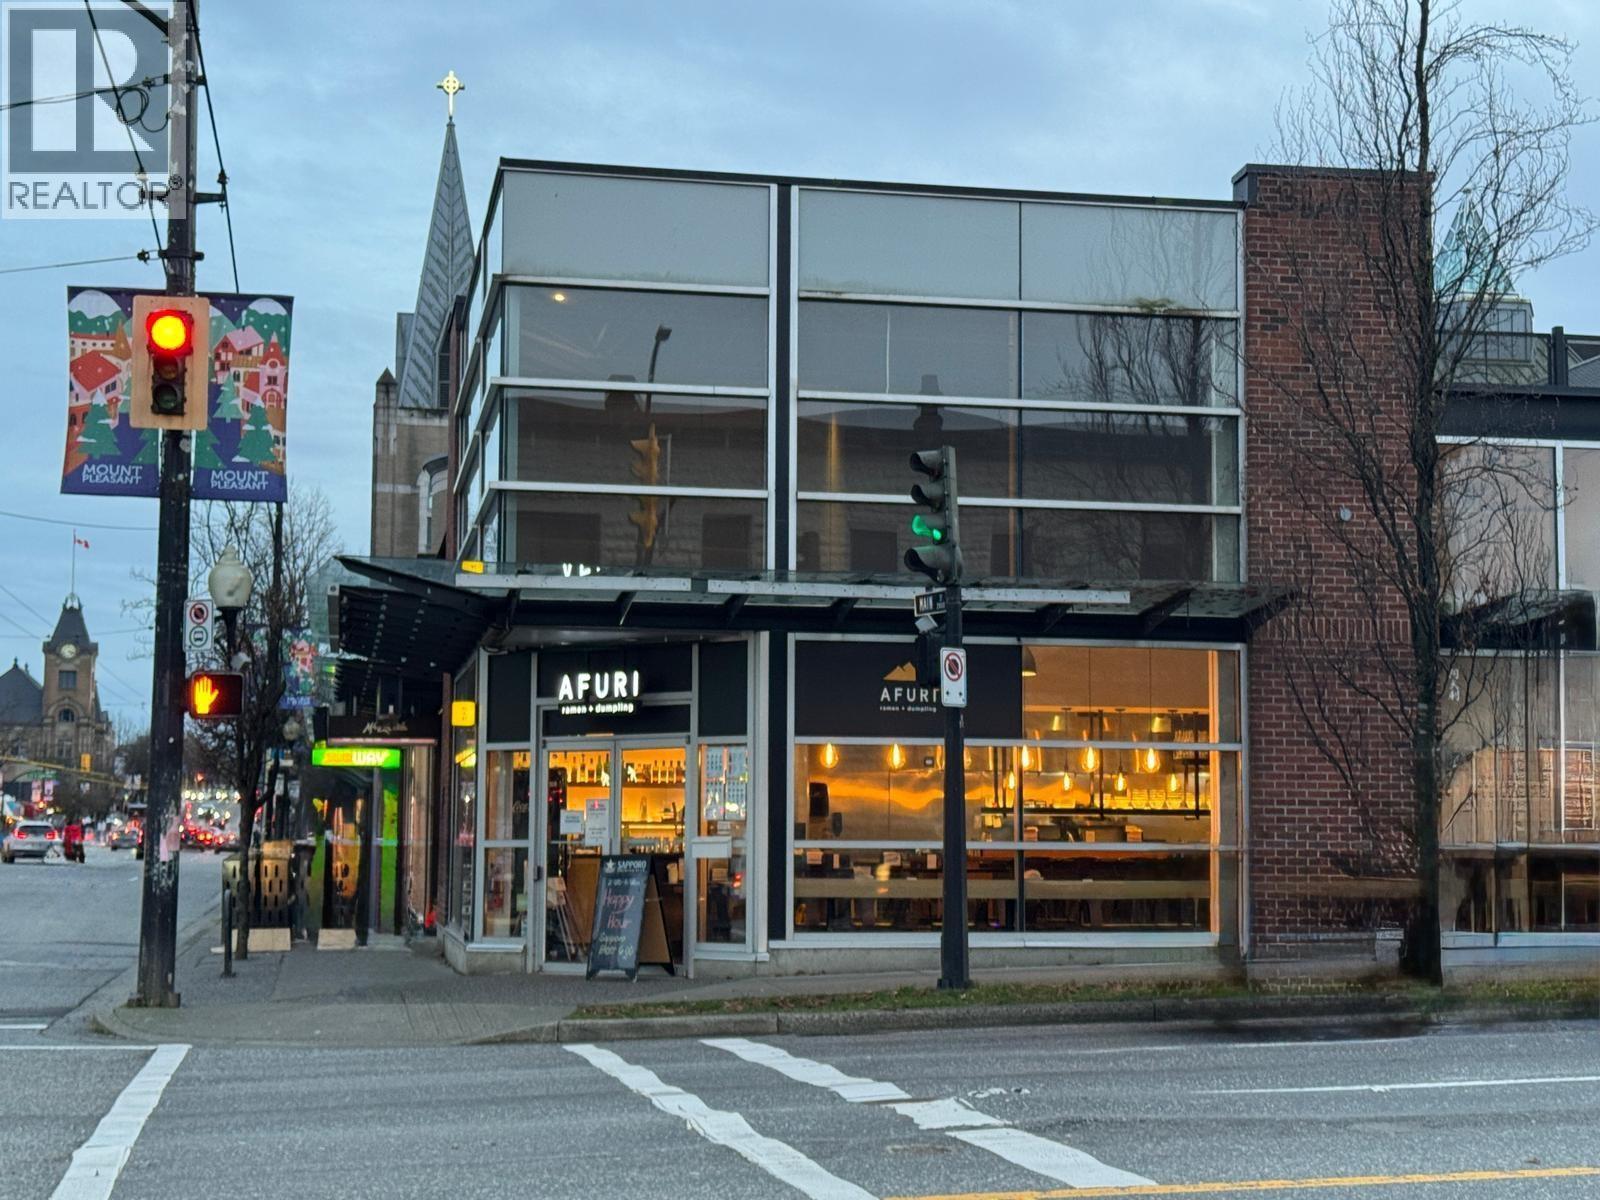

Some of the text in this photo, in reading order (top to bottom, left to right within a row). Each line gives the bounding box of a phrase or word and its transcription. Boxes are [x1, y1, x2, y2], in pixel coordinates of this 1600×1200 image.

[82, 464, 143, 477] MOUNT
[210, 470, 269, 482] MOUNT
[82, 474, 142, 485] PLEASANT
[210, 480, 269, 491] PLEASANT
[558, 669, 639, 701] AFURI
[880, 687, 938, 703] AFURI
[561, 704, 587, 715] ramen
[595, 701, 634, 714] dumpling
[906, 705, 937, 713] dumpling
[617, 860, 647, 870] SAPPORO
[603, 888, 634, 914] Happy
[607, 913, 632, 929] Hour
